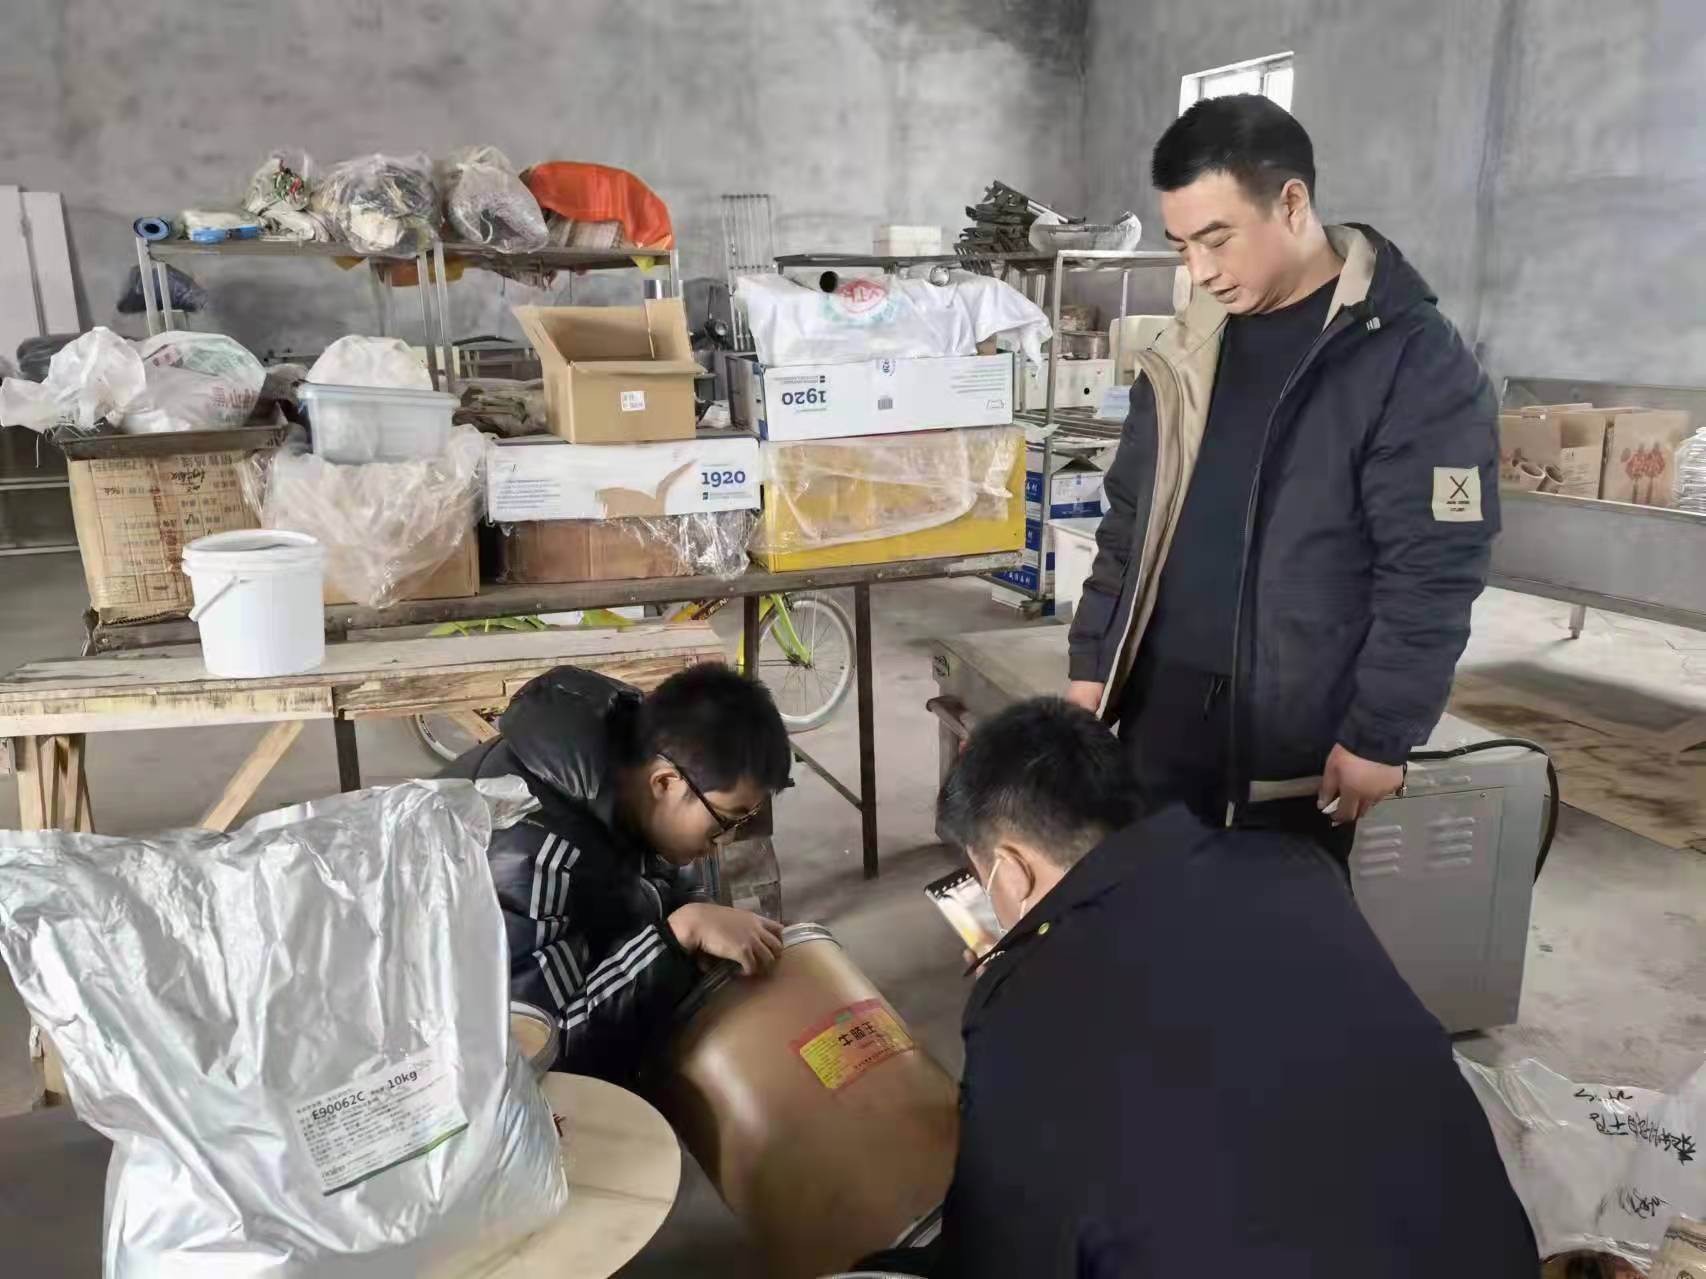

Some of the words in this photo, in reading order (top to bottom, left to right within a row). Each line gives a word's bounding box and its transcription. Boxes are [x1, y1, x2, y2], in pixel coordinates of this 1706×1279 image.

[781, 387, 827, 406] 1920
[700, 470, 747, 488] 1920
[311, 1090, 366, 1121] E90062C
[387, 1070, 418, 1089] 10kg
